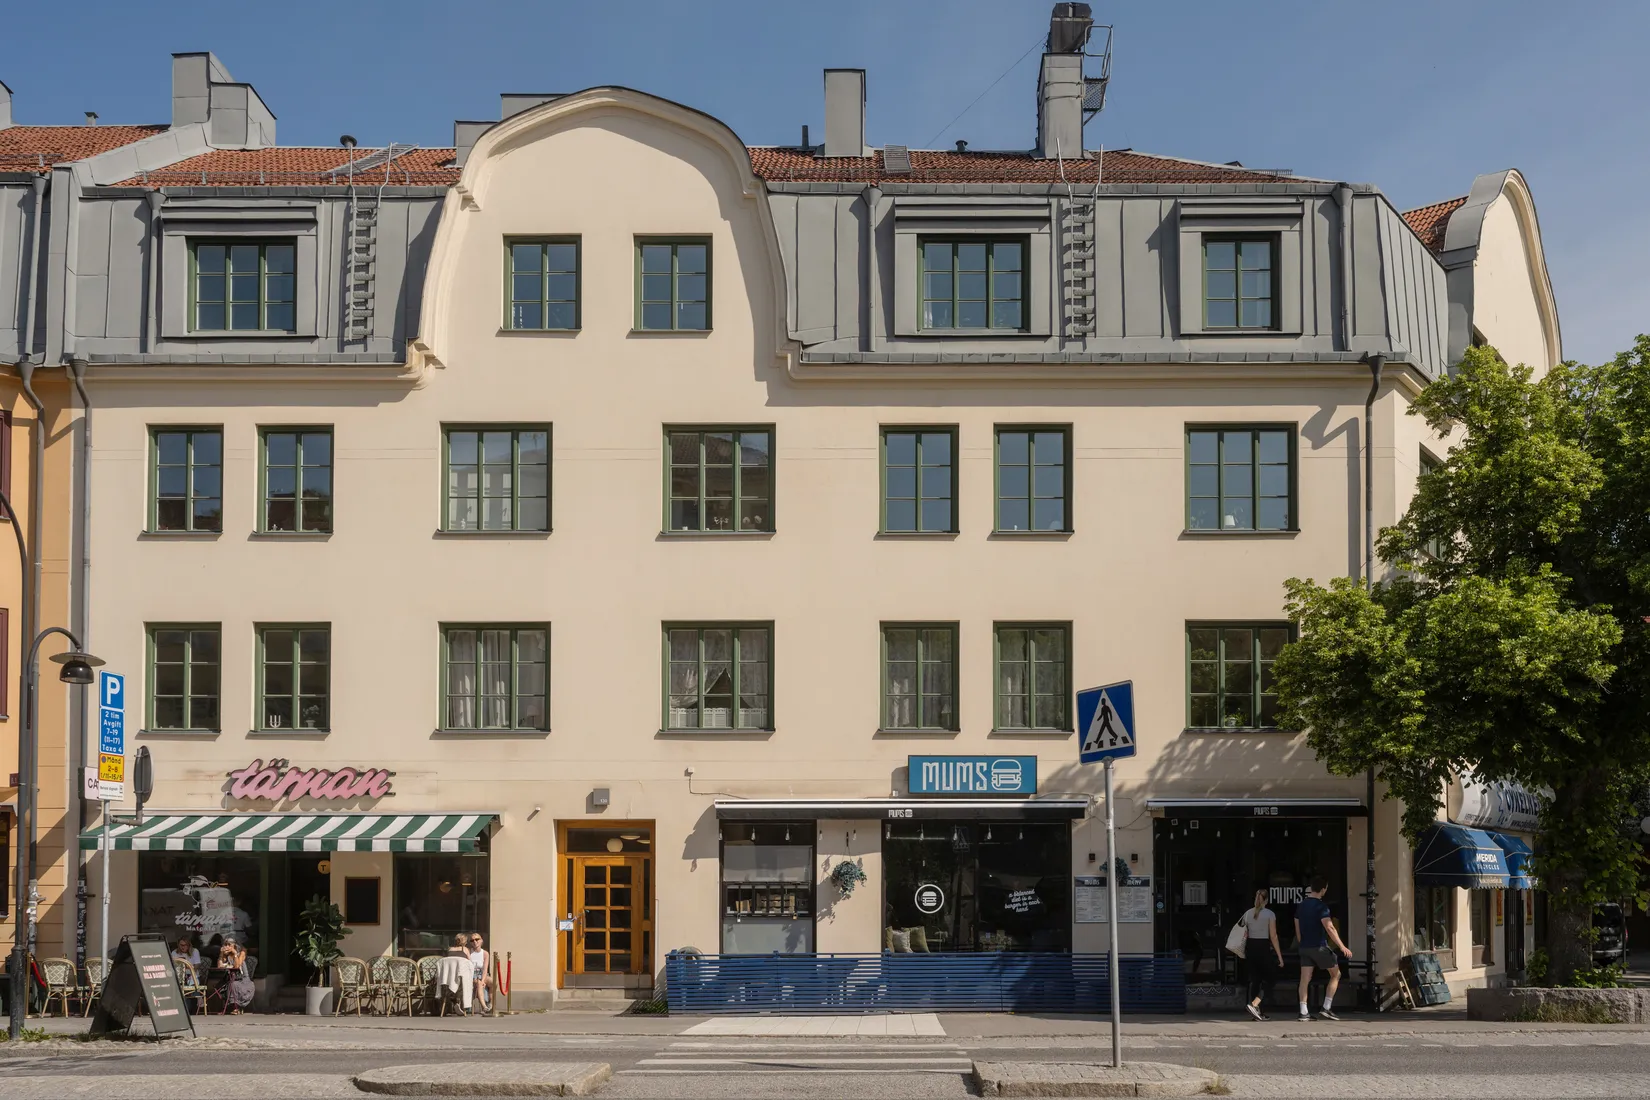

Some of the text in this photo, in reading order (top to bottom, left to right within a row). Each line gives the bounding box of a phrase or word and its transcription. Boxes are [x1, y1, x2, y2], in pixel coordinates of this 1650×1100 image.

[106, 676, 120, 705] P
[103, 719, 122, 728] Avgift
[106, 728, 119, 736] 7-19
[104, 735, 121, 745] (11-17)
[102, 744, 117, 752] Taxa
[922, 762, 988, 791] MUMS
[888, 809, 904, 818] MUMS
[1253, 807, 1270, 815] MUMS
[1476, 853, 1498, 863] MERIDA
[1269, 887, 1303, 904] MUMS
